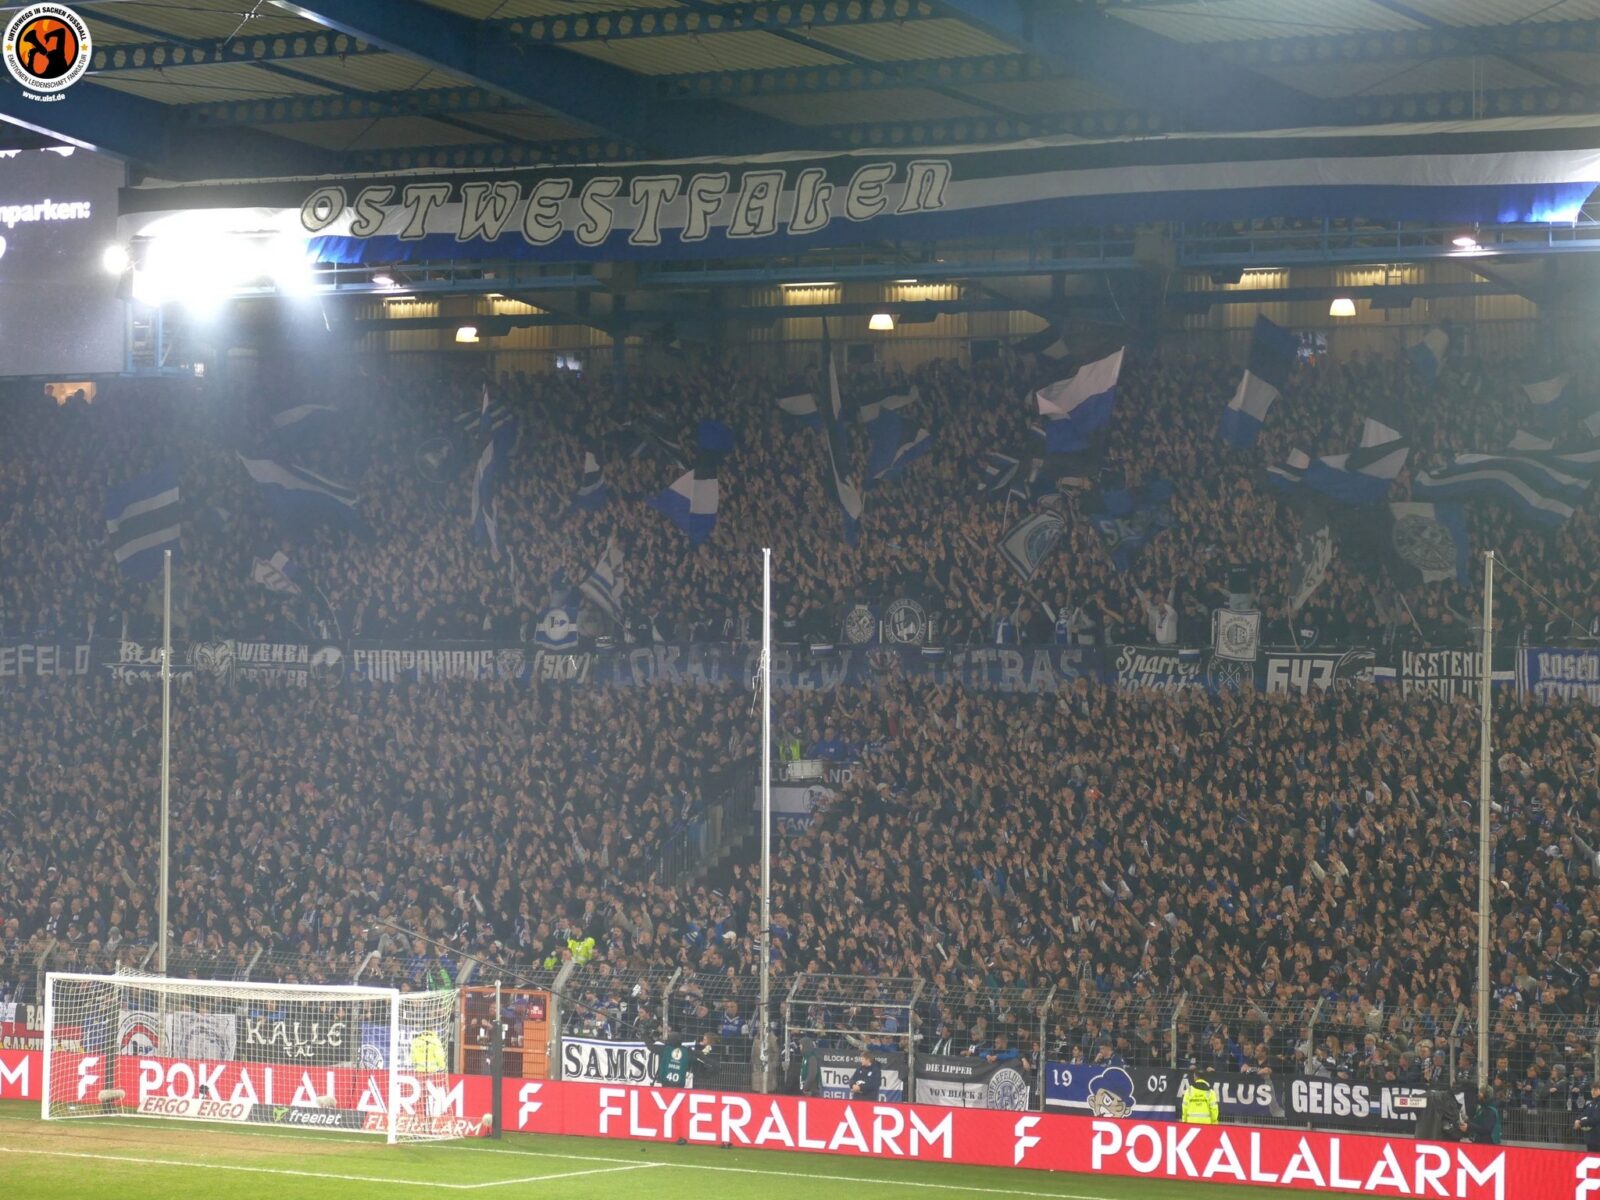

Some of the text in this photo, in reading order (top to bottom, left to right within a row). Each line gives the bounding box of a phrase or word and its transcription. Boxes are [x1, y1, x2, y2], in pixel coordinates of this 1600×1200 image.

[300, 159, 951, 247] OSTWESTFALEN
[1265, 658, 1334, 695] 647
[245, 1018, 347, 1048] KALLE
[823, 1054, 845, 1063] BLOCK
[666, 1072, 680, 1083] 40
[823, 1070, 851, 1086] The
[925, 1063, 973, 1076] DIE LIPPER
[1053, 1069, 1073, 1088] 19
[1147, 1075, 1168, 1093] 05
[929, 1087, 947, 1098] VON
[948, 1089, 976, 1100] BLOCK
[142, 1096, 245, 1119] ERGO ERGO
[289, 1110, 342, 1126] freenet
[599, 1087, 953, 1159] FLYERALARM
[1091, 1120, 1506, 1200] POKALALARM
